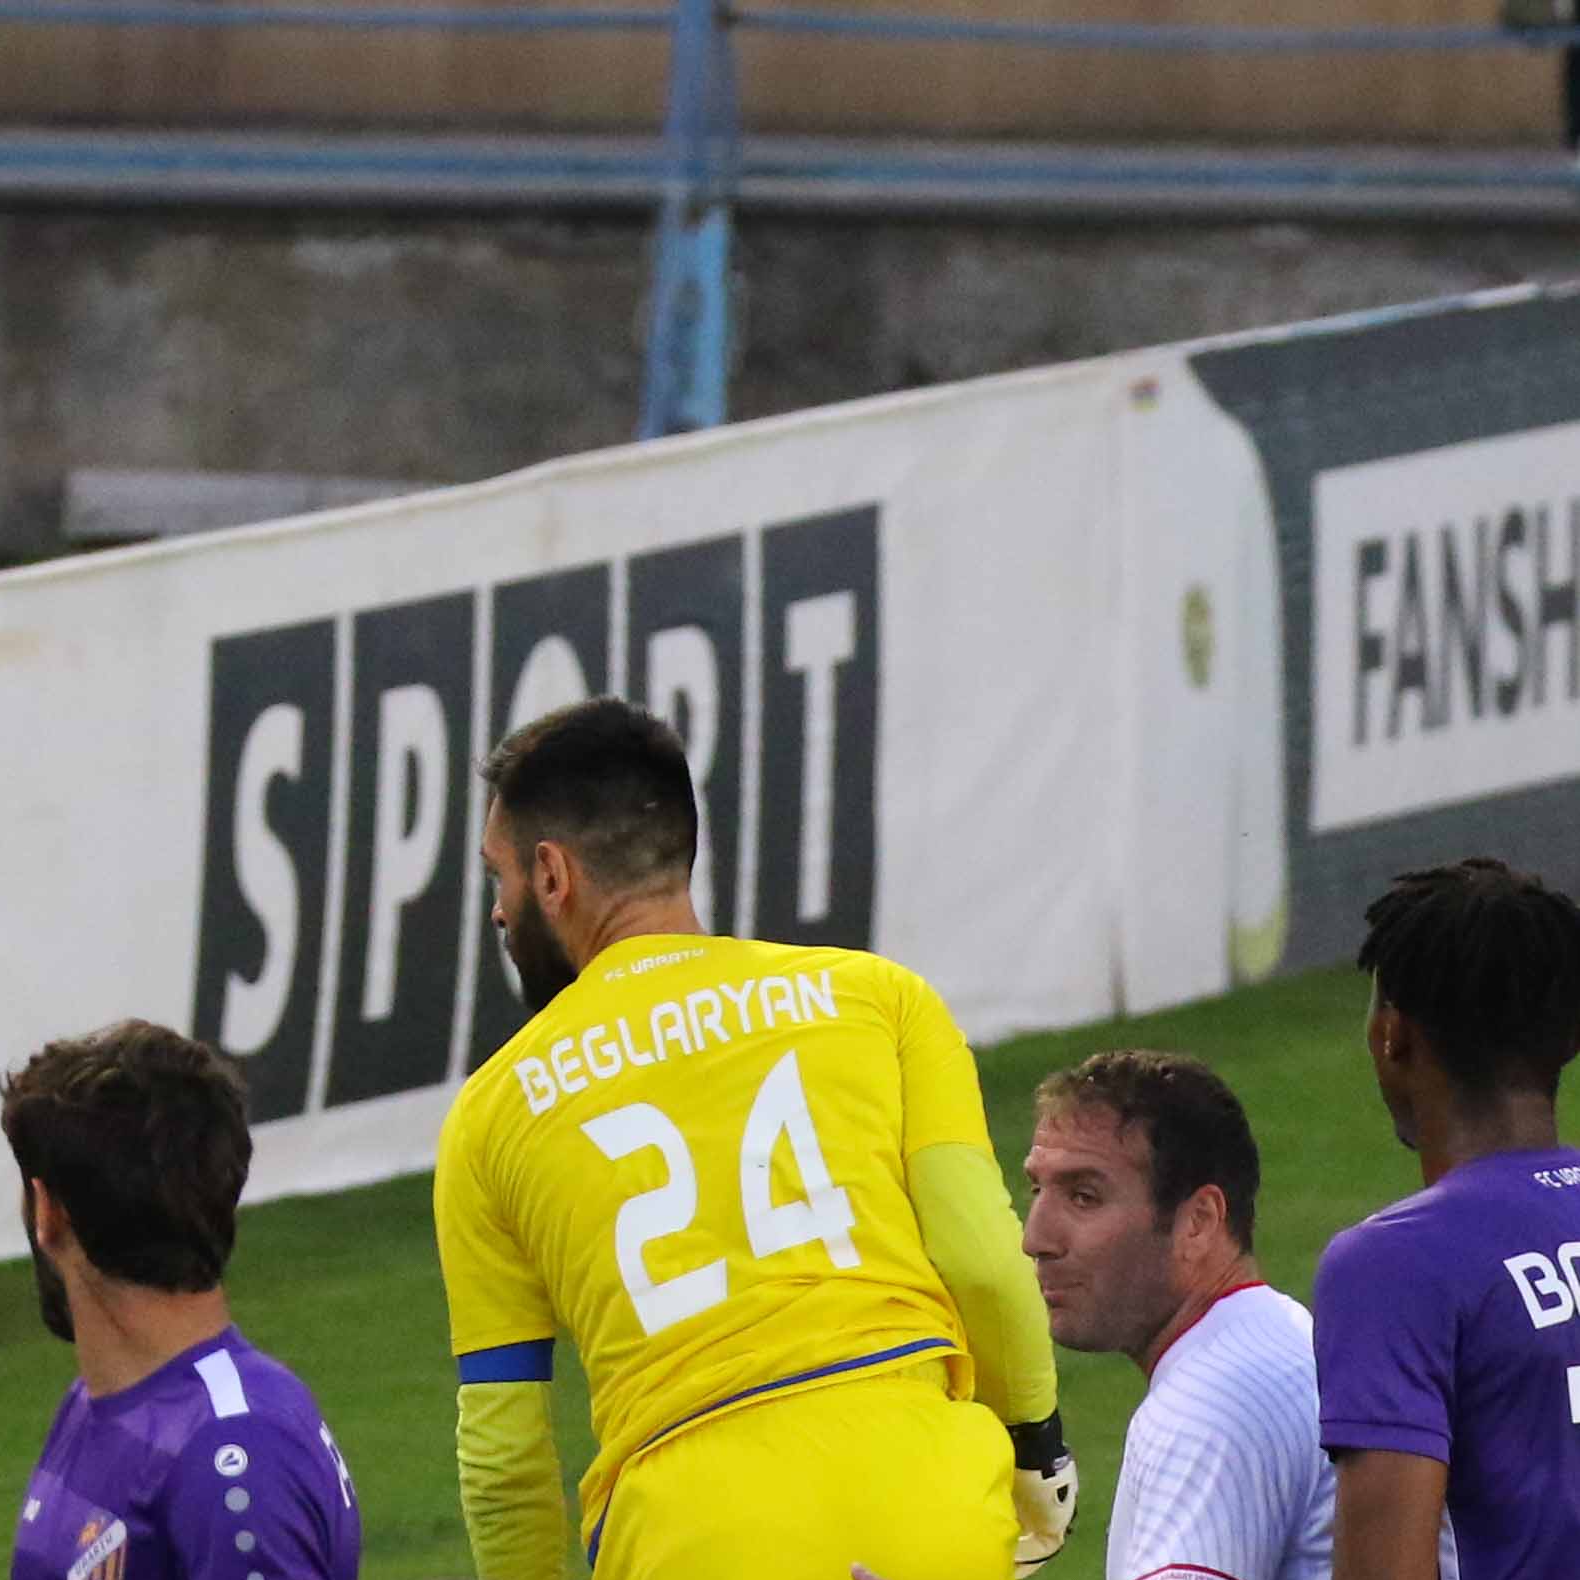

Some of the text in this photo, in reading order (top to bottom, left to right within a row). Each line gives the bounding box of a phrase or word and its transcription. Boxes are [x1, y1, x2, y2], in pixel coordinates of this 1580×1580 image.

[1352, 496, 1580, 746] FANSH
[219, 592, 855, 1058] SPRT
[513, 968, 839, 1117] BEGLARYAN
[580, 1048, 862, 1335] 24
[1503, 1242, 1580, 1330] B
